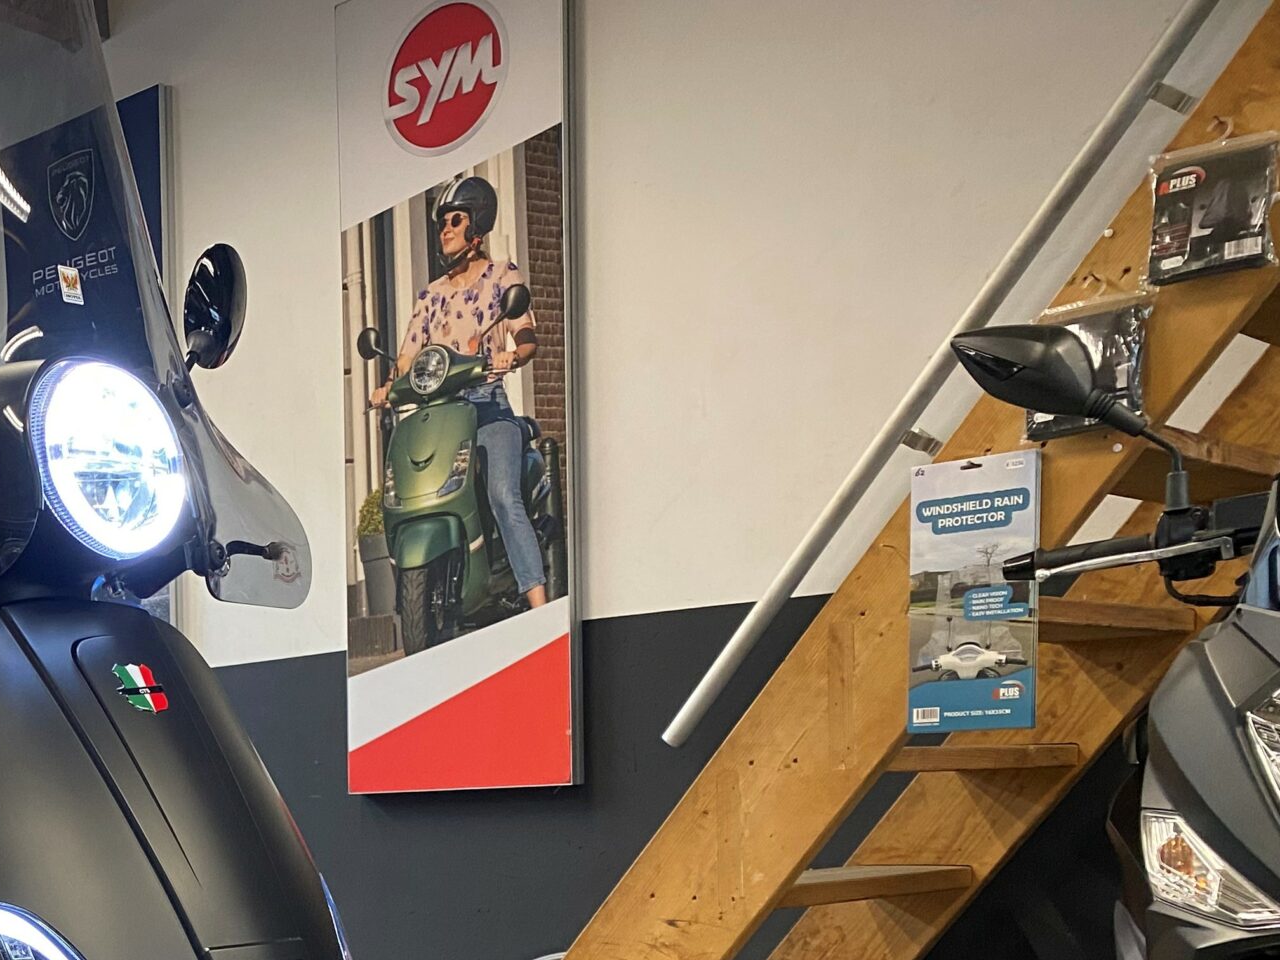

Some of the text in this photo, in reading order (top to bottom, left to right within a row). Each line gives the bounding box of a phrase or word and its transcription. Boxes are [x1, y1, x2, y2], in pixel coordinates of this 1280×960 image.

[386, 31, 503, 127] SYM
[32, 246, 117, 285] PEGEOT
[34, 263, 119, 298] MOTYCLES
[922, 494, 1024, 517] WINDSHIELD RAIN
[937, 511, 1005, 529] PROTECTOR
[943, 710, 970, 718] PRODUCT
